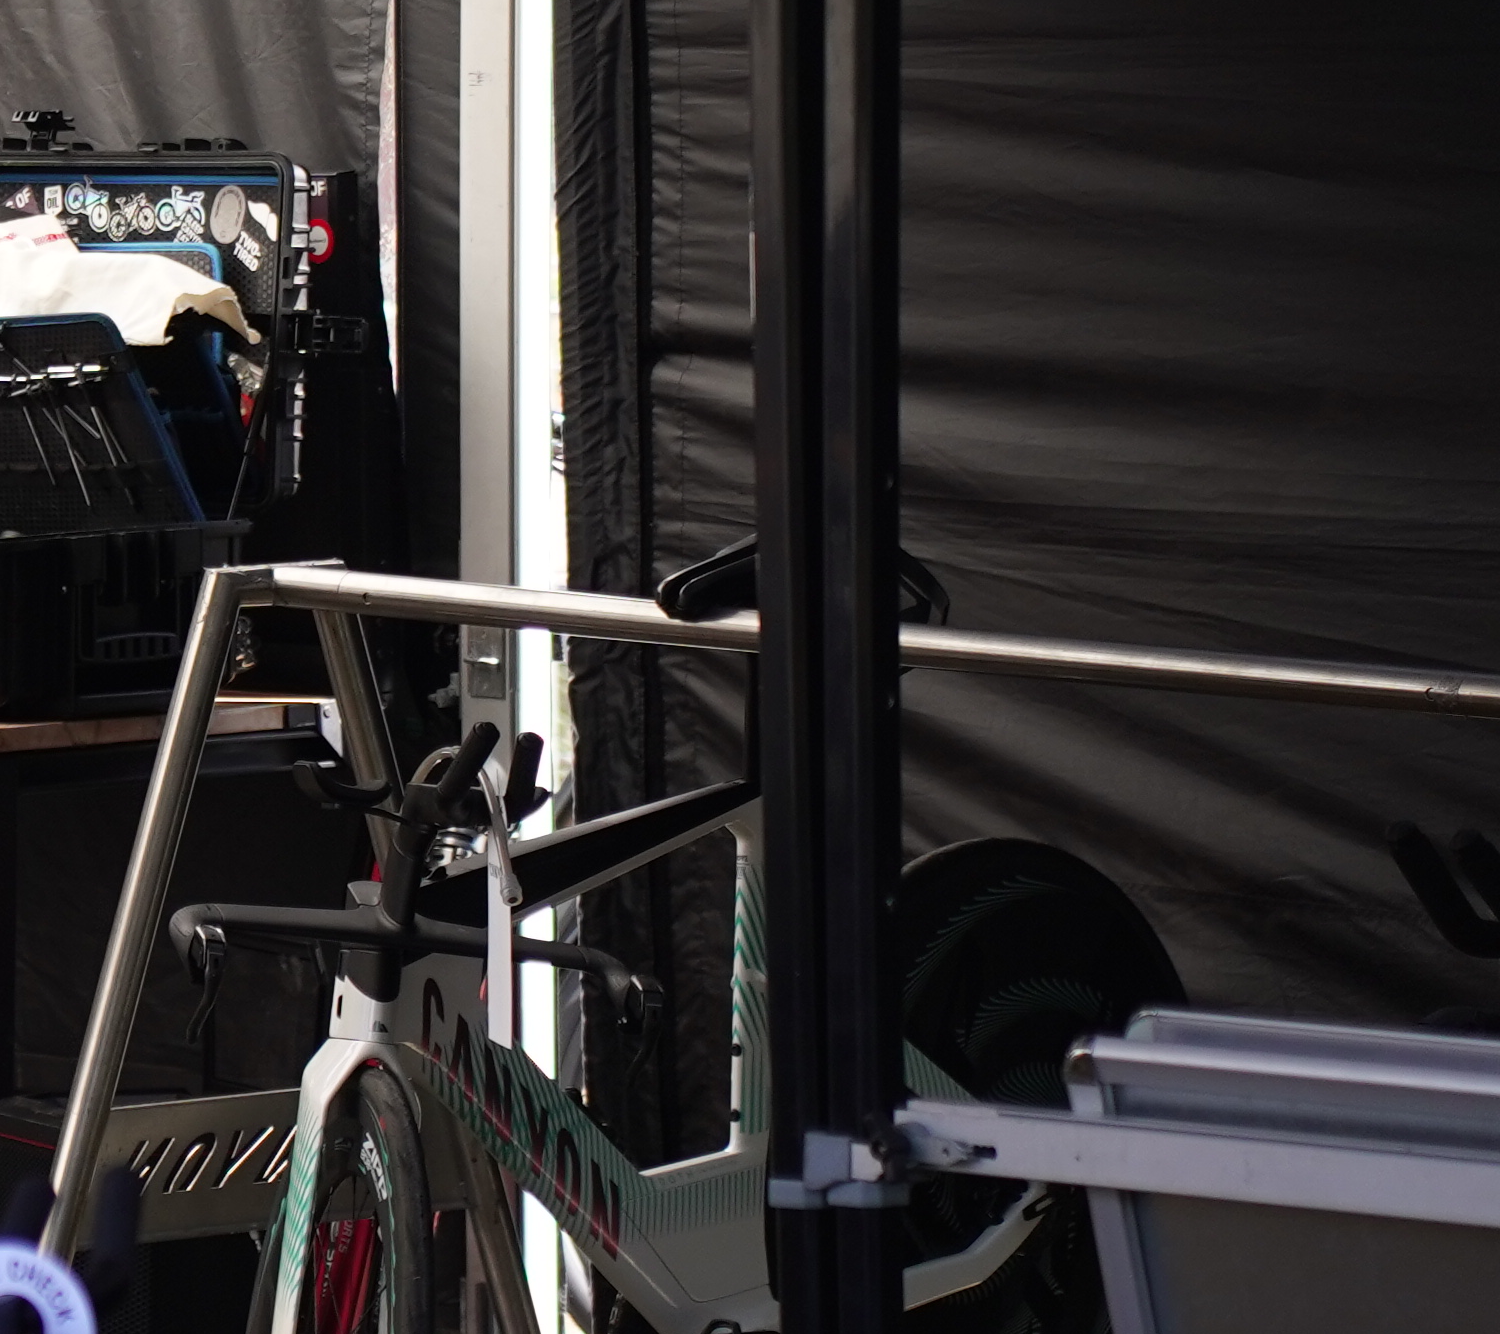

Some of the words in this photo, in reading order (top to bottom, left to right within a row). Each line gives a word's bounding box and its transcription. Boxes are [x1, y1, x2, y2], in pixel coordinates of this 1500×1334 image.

[232, 242, 258, 272] TIRED
[239, 231, 261, 256] TWO-
[422, 977, 620, 1261] CANYON
